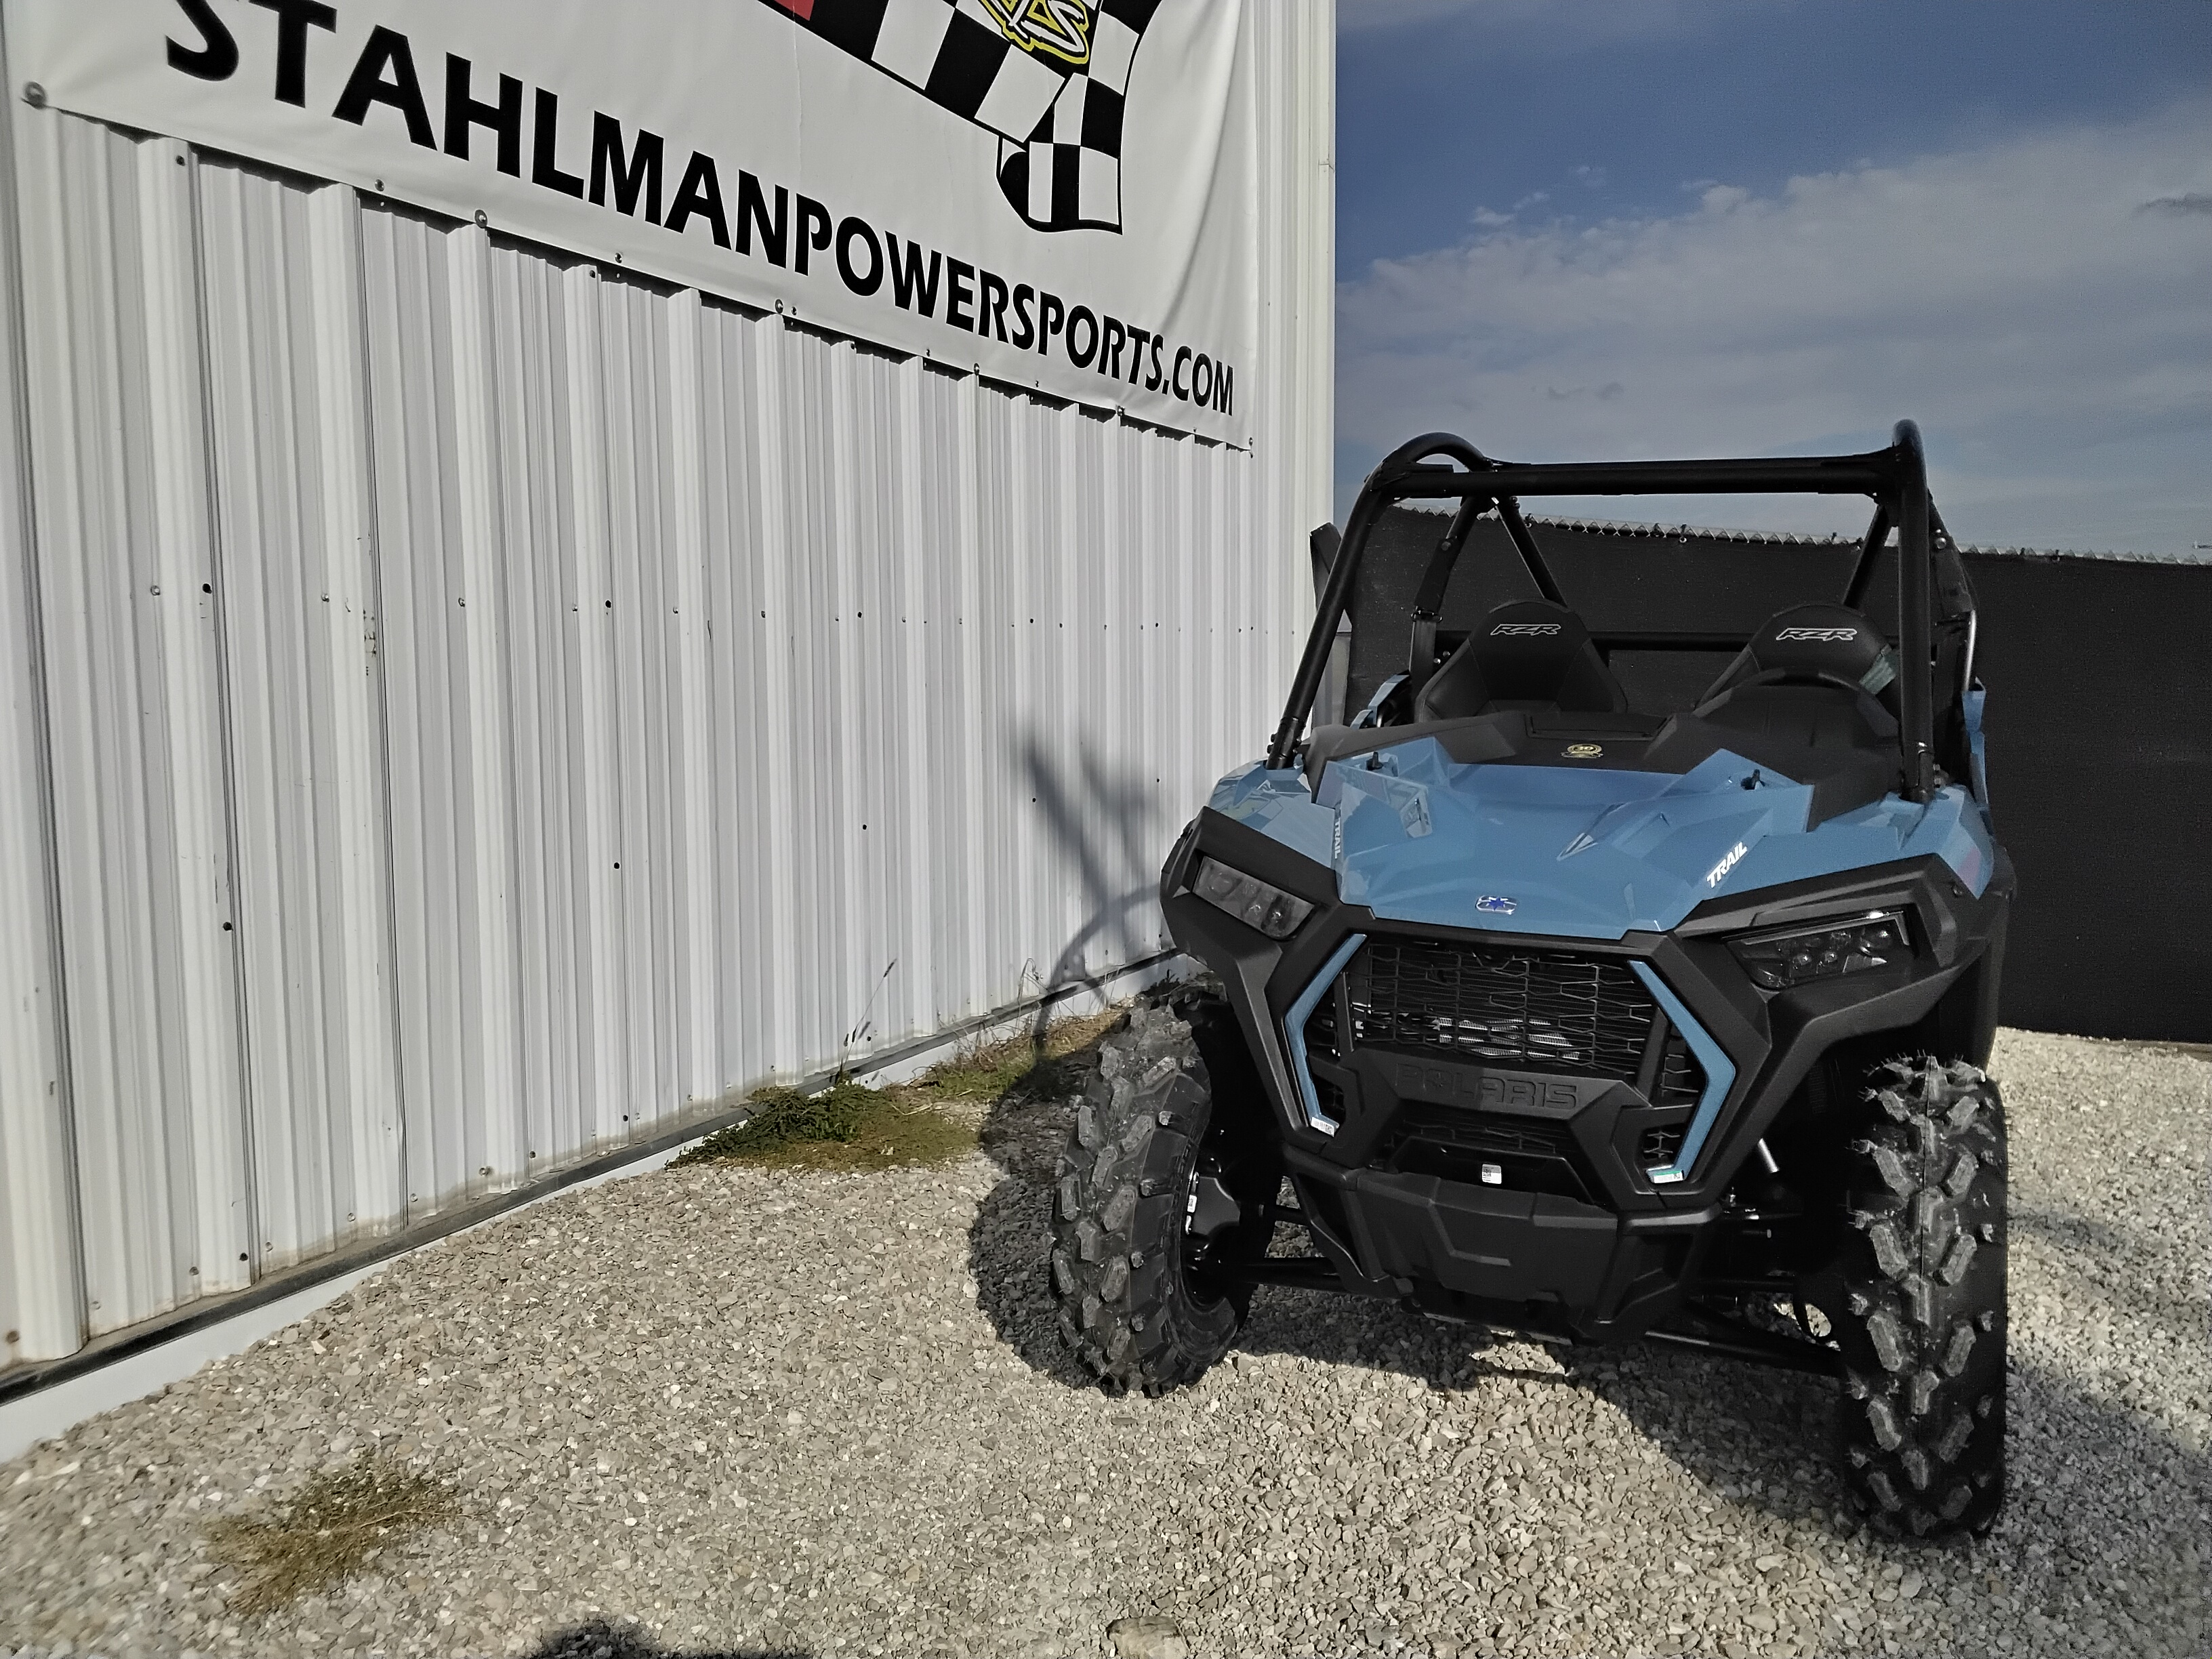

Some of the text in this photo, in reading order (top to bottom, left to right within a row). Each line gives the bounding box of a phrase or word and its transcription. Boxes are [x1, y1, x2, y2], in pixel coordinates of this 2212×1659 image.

[166, 0, 1233, 416] STAHLMANPOWERSPORTS.COM
[1490, 623, 1561, 636] RZR
[1776, 628, 1857, 641] RZR
[1706, 842, 1748, 888] TRAIL
[1395, 1063, 1577, 1109] POLARIS
